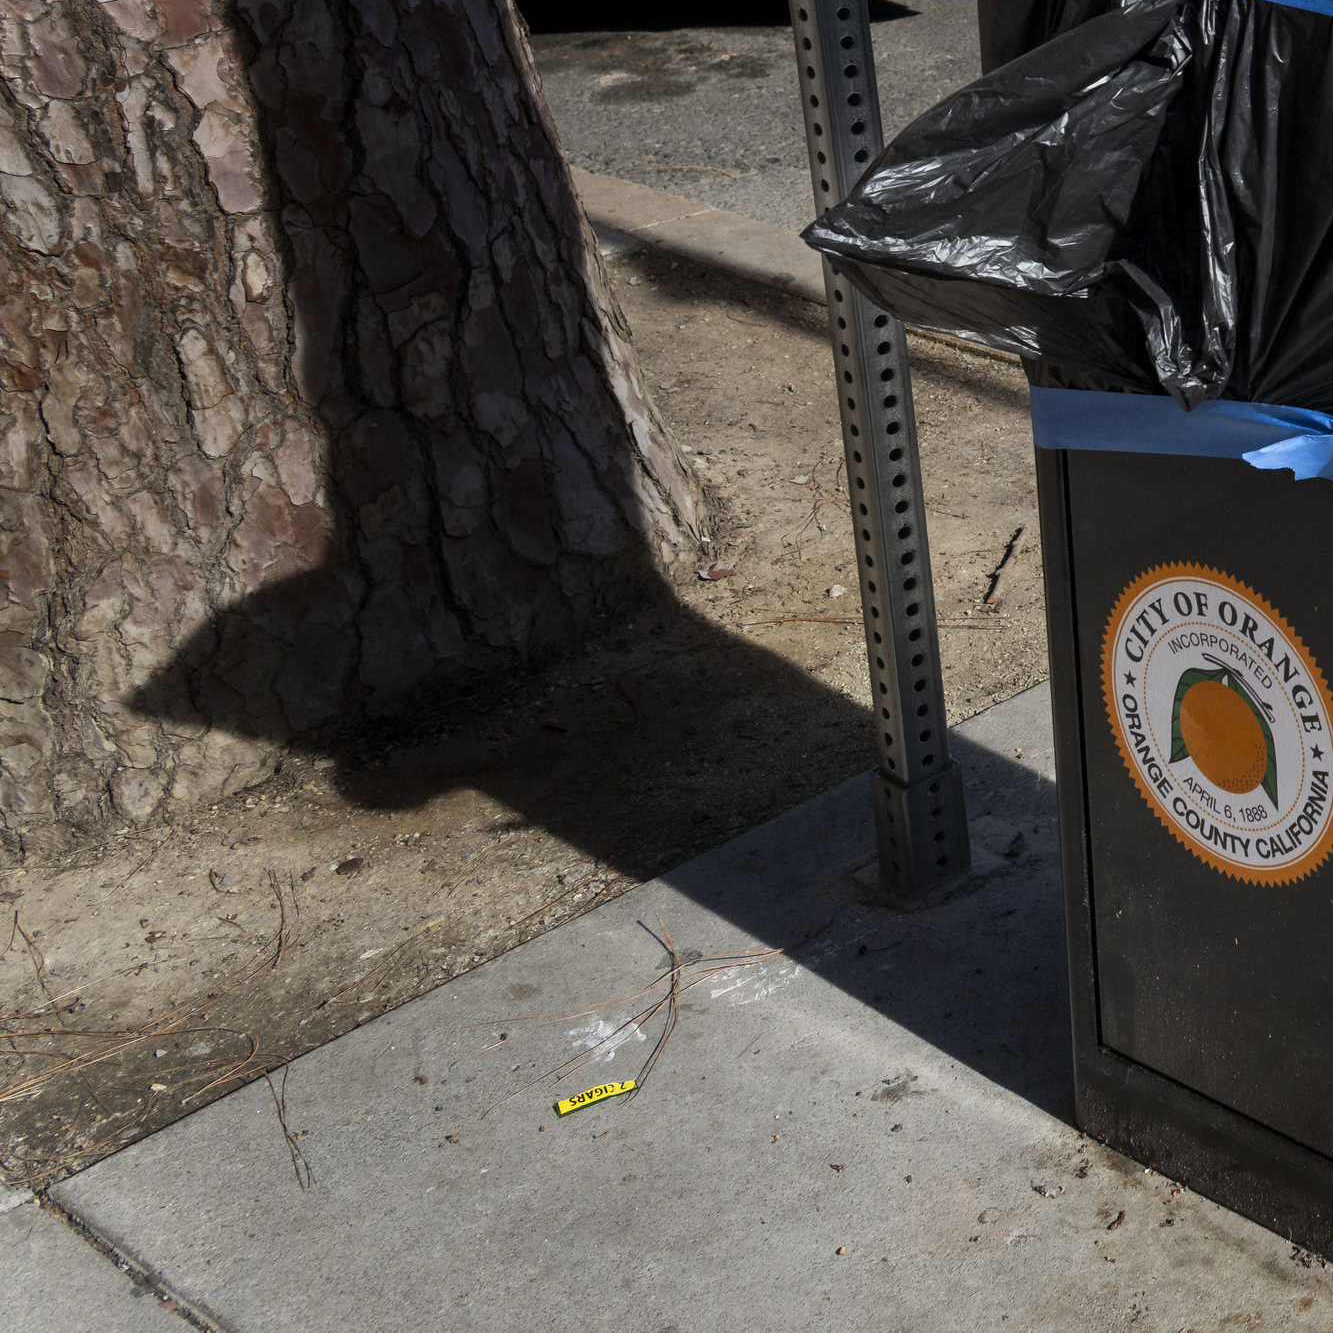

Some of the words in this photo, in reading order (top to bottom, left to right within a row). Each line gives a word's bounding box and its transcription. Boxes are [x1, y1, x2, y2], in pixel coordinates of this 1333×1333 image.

[1124, 598, 1171, 663] CITY
[1172, 591, 1209, 617] OF
[1218, 600, 1322, 734] ORANGE
[1168, 632, 1273, 689] INCORPORATED
[1122, 693, 1174, 799] ORANGE
[1171, 796, 1251, 858] COUNTY
[1255, 769, 1329, 859] CALIFORNIA
[1183, 776, 1222, 815] APRIL
[1224, 805, 1237, 823] 6,
[1239, 804, 1268, 823] 1888
[569, 1084, 615, 1106] CIGARS
